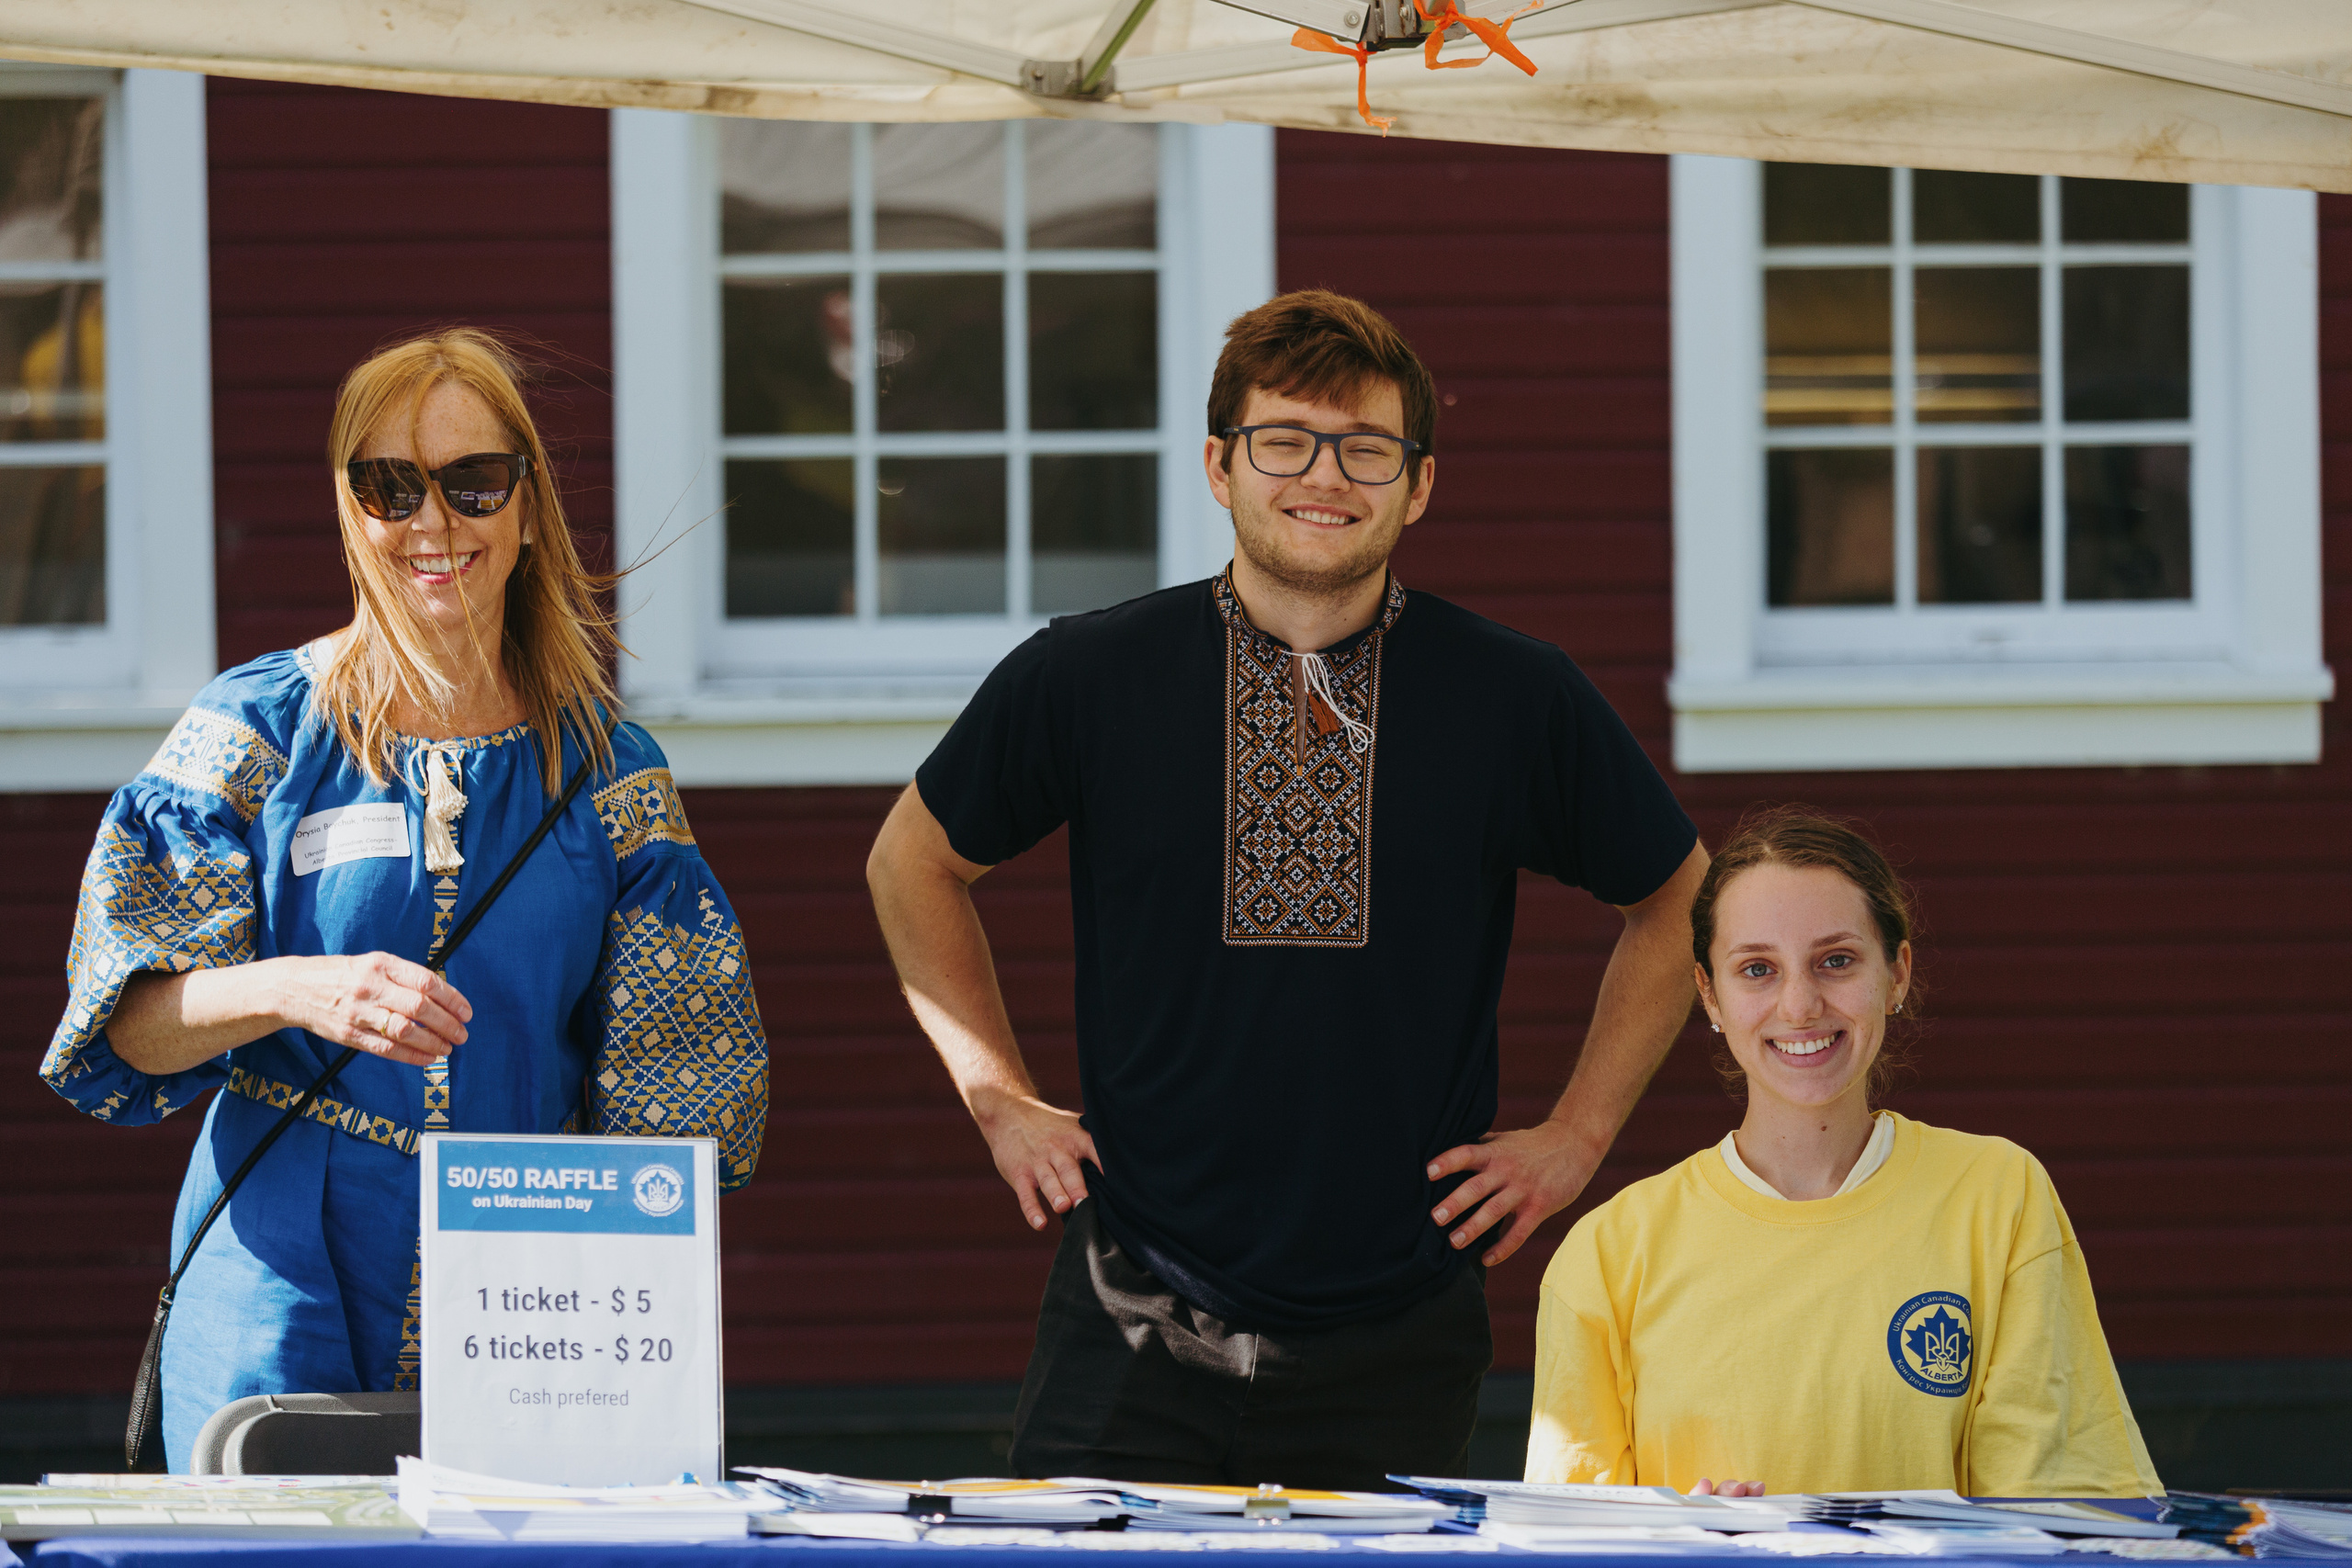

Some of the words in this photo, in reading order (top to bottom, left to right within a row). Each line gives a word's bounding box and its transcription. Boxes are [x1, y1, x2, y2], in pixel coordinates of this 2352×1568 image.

[296, 826, 321, 838] Orysia
[363, 815, 401, 823] President
[312, 854, 335, 865] Albeta
[447, 1167, 518, 1190] 50/50
[524, 1168, 618, 1190] RAFFLE
[471, 1197, 492, 1208] on
[493, 1195, 562, 1209] Ukrainian
[564, 1196, 594, 1213] Day
[477, 1287, 488, 1312] 1
[502, 1286, 581, 1313] ticket
[611, 1285, 626, 1316] $
[637, 1290, 651, 1314] 5
[1893, 1301, 1921, 1332] Ukrainian
[1921, 1295, 1962, 1305] Canadian
[464, 1335, 479, 1359] 6
[489, 1335, 583, 1360] tickets
[615, 1334, 629, 1365] $
[640, 1337, 673, 1362] 20
[1920, 1368, 1964, 1382] ALBERTA
[509, 1388, 552, 1405] Cash
[558, 1388, 629, 1409] prefered
